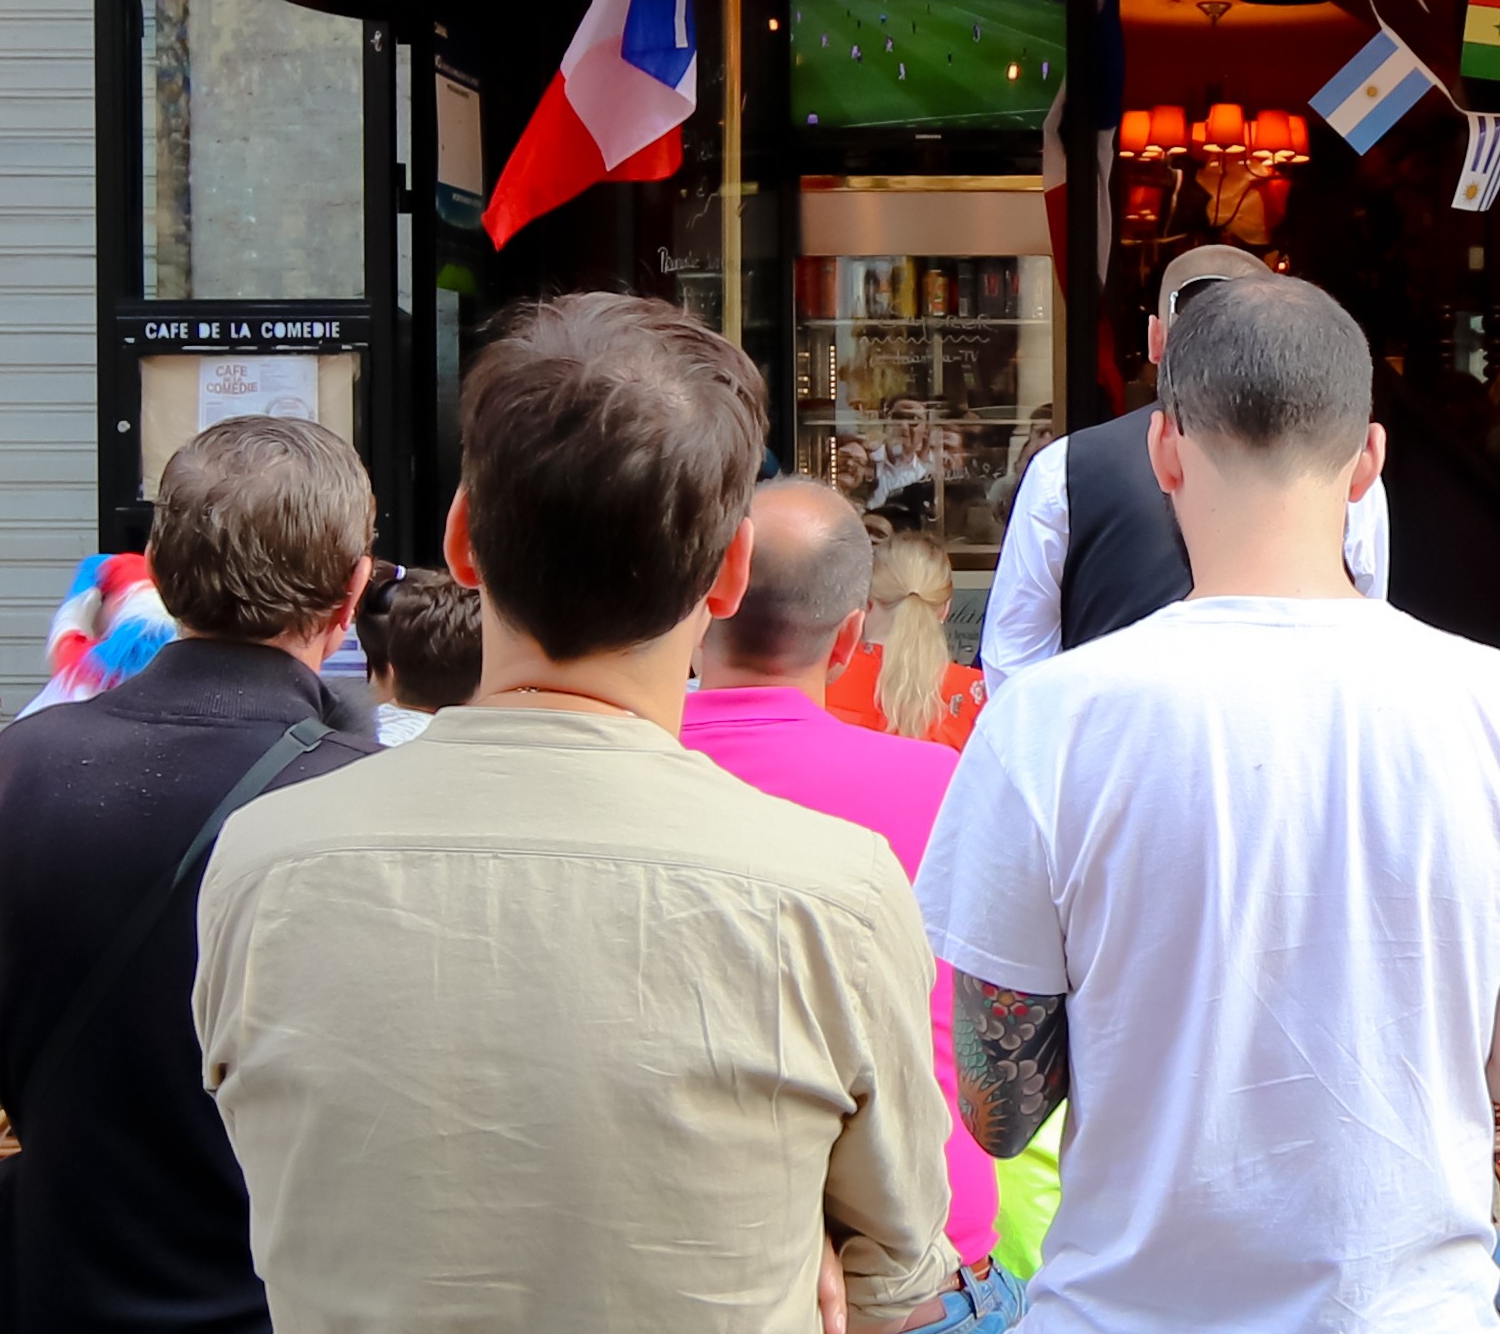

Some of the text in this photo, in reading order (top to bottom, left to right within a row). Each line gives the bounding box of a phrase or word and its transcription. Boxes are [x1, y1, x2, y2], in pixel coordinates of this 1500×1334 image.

[145, 321, 340, 339] CAFE DE LA COMEDIE
[215, 364, 248, 377] CAFE
[206, 381, 258, 395] COMEDIE
